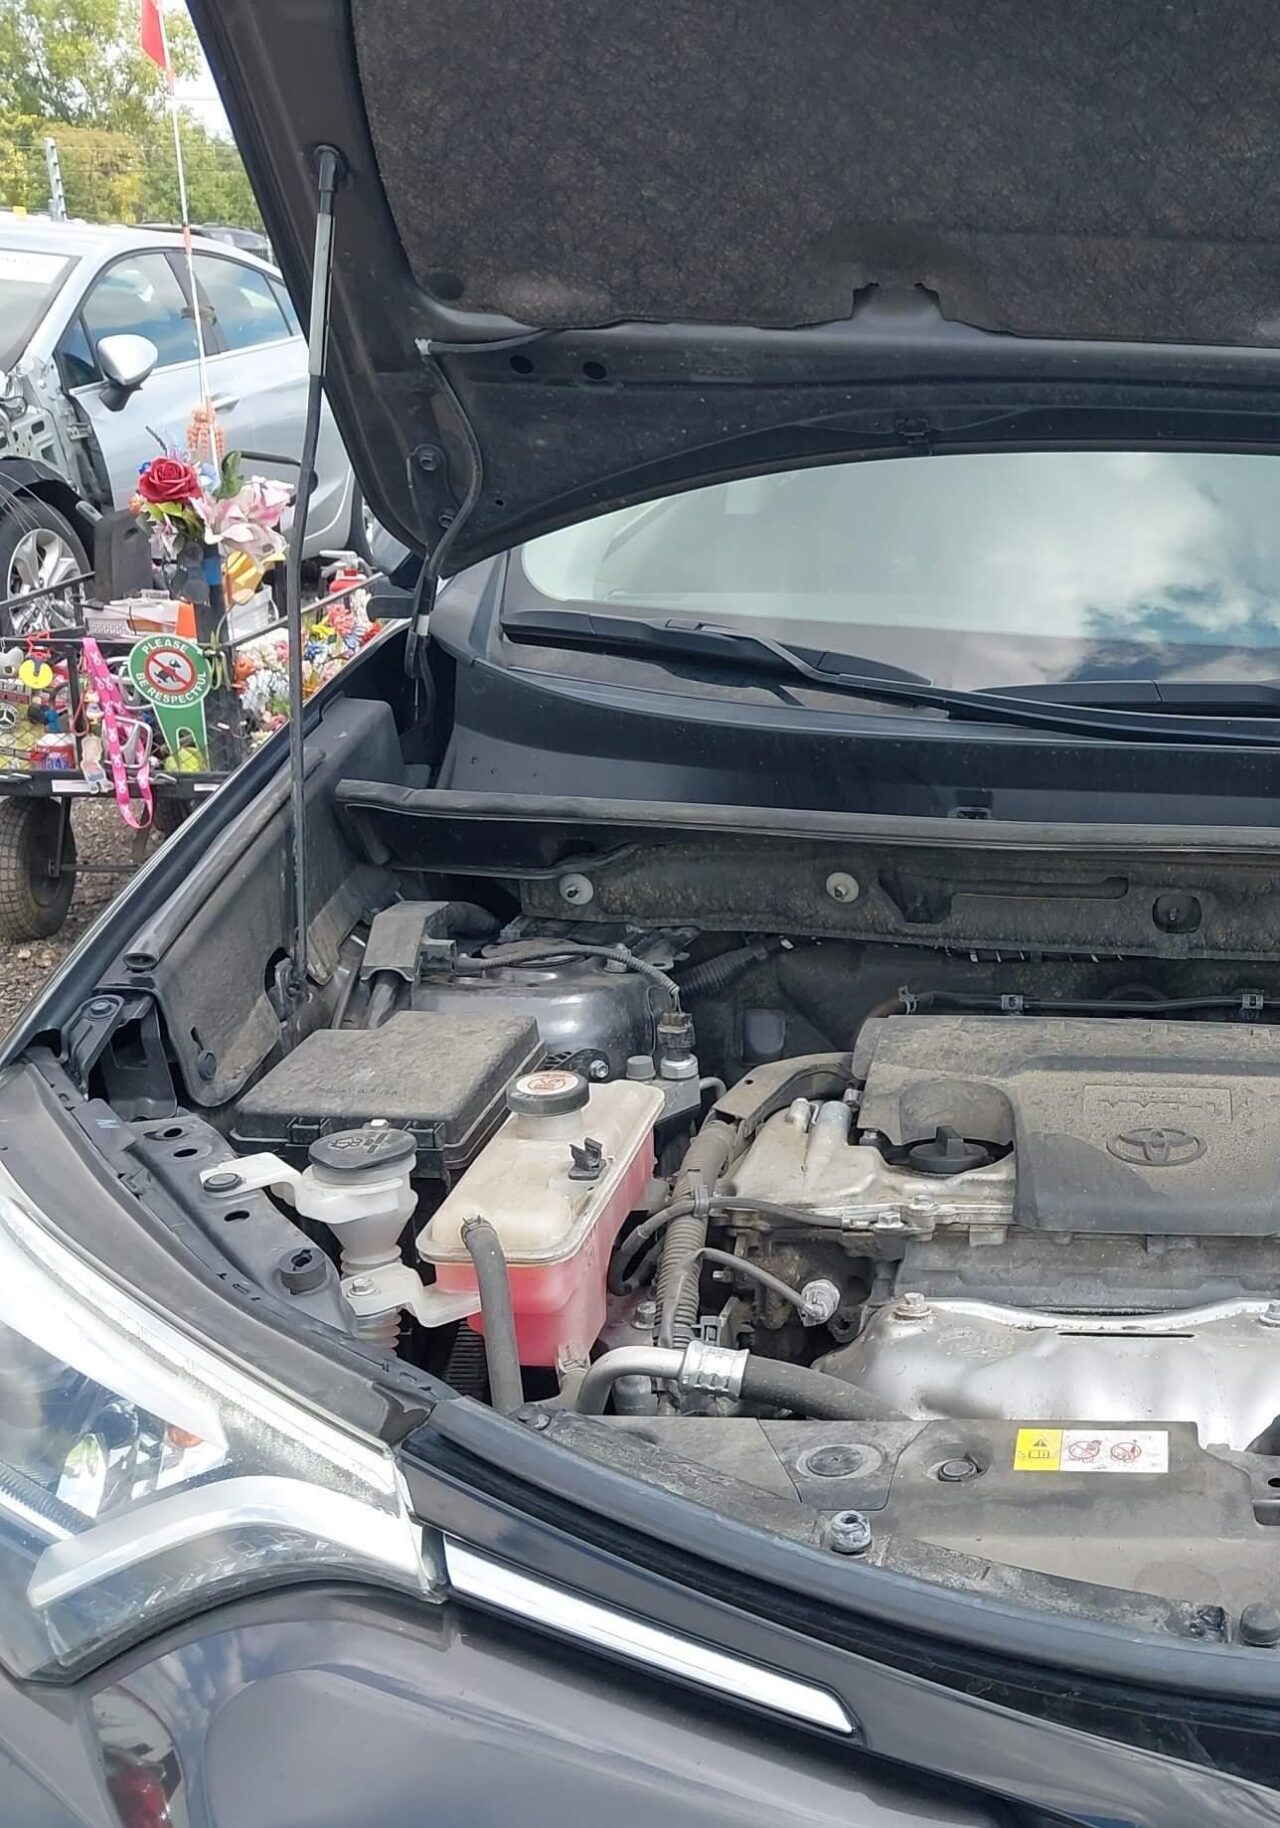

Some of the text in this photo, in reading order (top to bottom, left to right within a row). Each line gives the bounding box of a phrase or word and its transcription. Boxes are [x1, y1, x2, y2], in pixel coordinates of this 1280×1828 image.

[141, 638, 189, 655] PLEASE
[135, 671, 207, 704] BE RESPECTFUL
